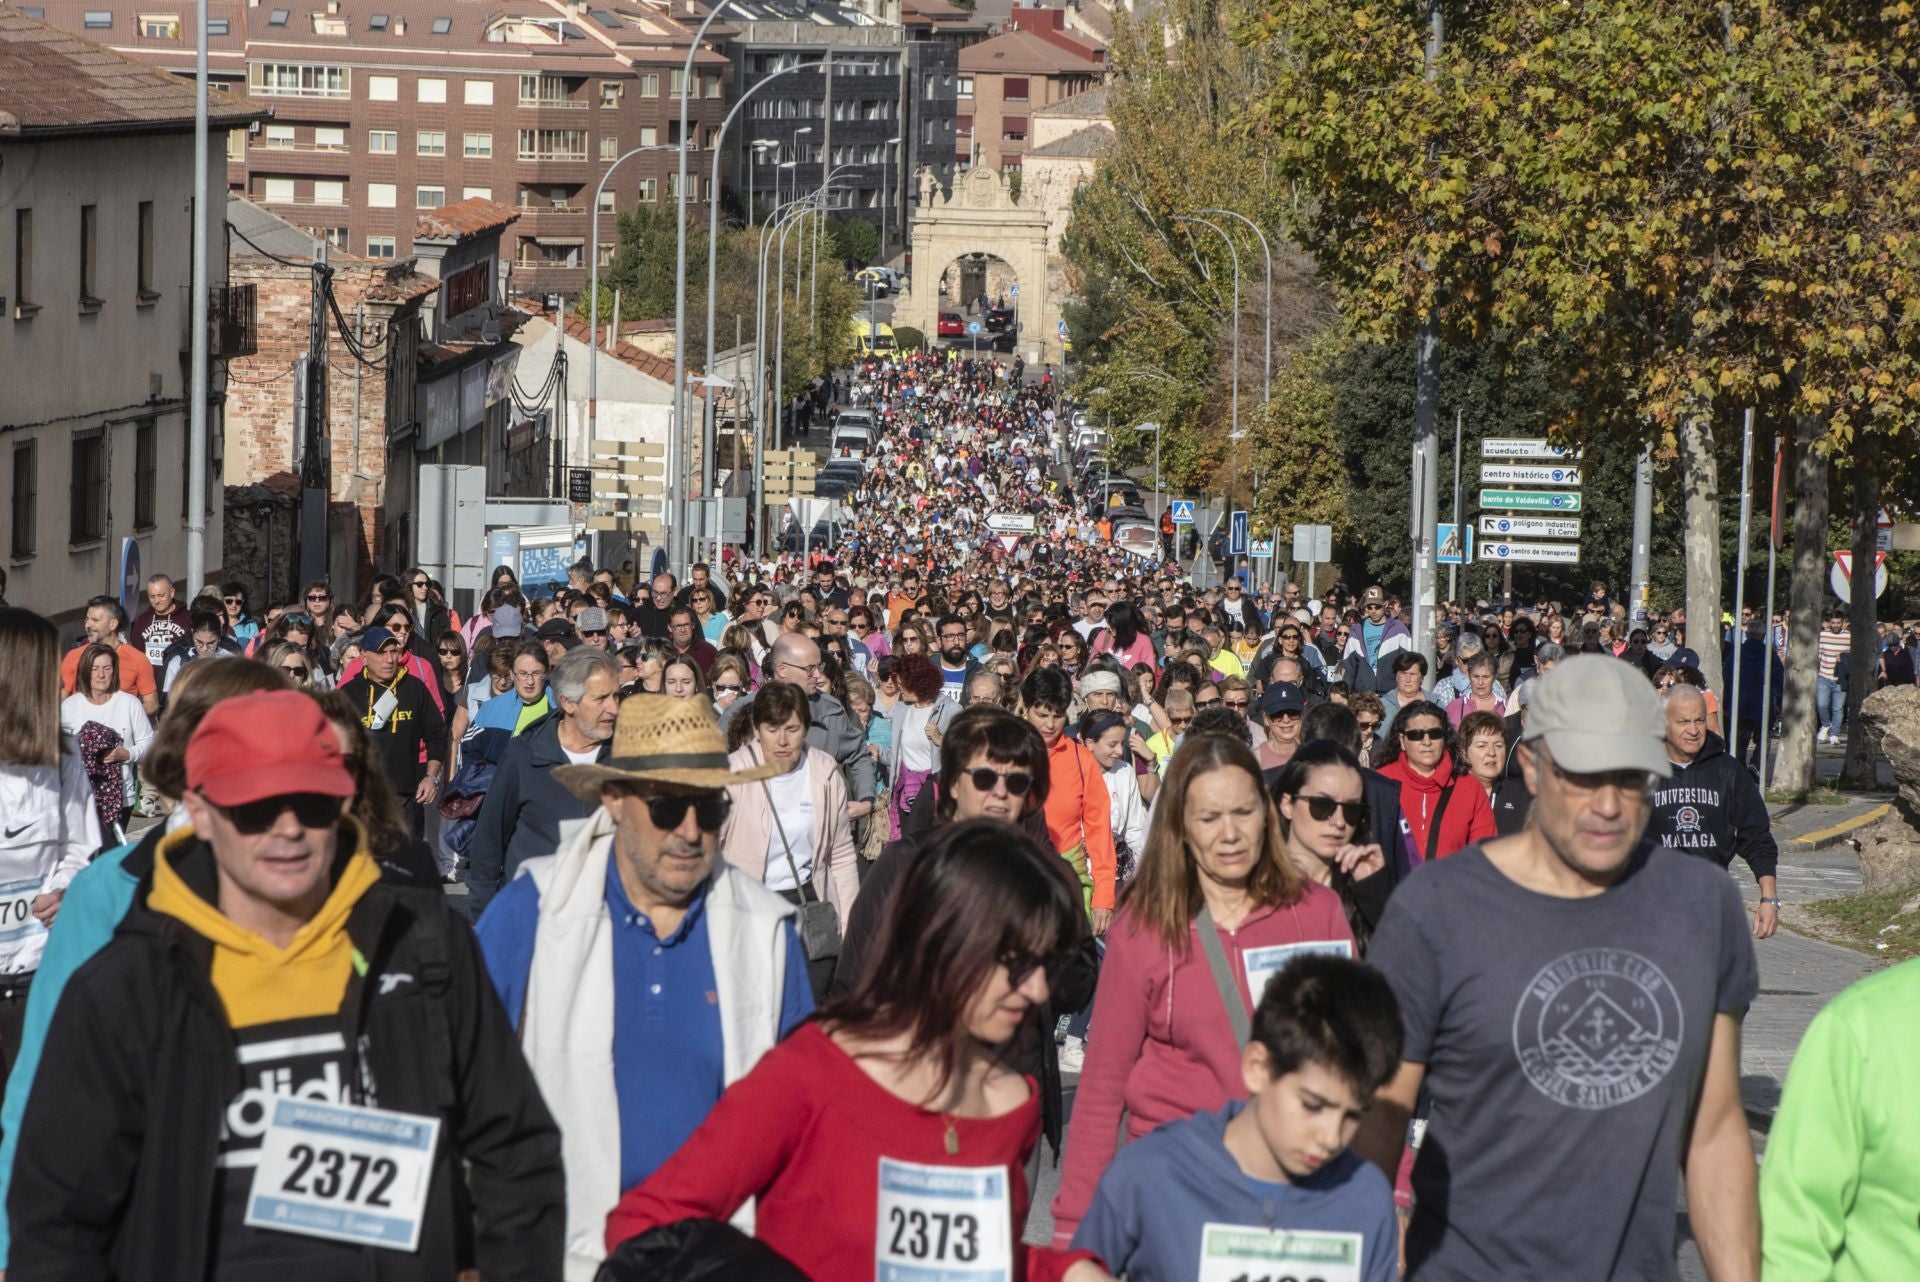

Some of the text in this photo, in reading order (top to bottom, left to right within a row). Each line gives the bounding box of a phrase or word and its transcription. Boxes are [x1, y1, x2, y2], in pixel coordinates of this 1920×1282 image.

[1513, 470, 1549, 479] histórico
[1516, 496, 1550, 505] Valdevilla
[1545, 521, 1578, 529] industrial
[523, 548, 560, 561] BLUE
[1541, 549, 1577, 557] transportes
[142, 621, 185, 639] AUTHENTIC
[1655, 787, 1719, 807] UNIVERSIDAD
[1533, 953, 1663, 1001] AUTHENTIC CLUB
[282, 1143, 397, 1208] 2372
[890, 1206, 979, 1262] 2373
